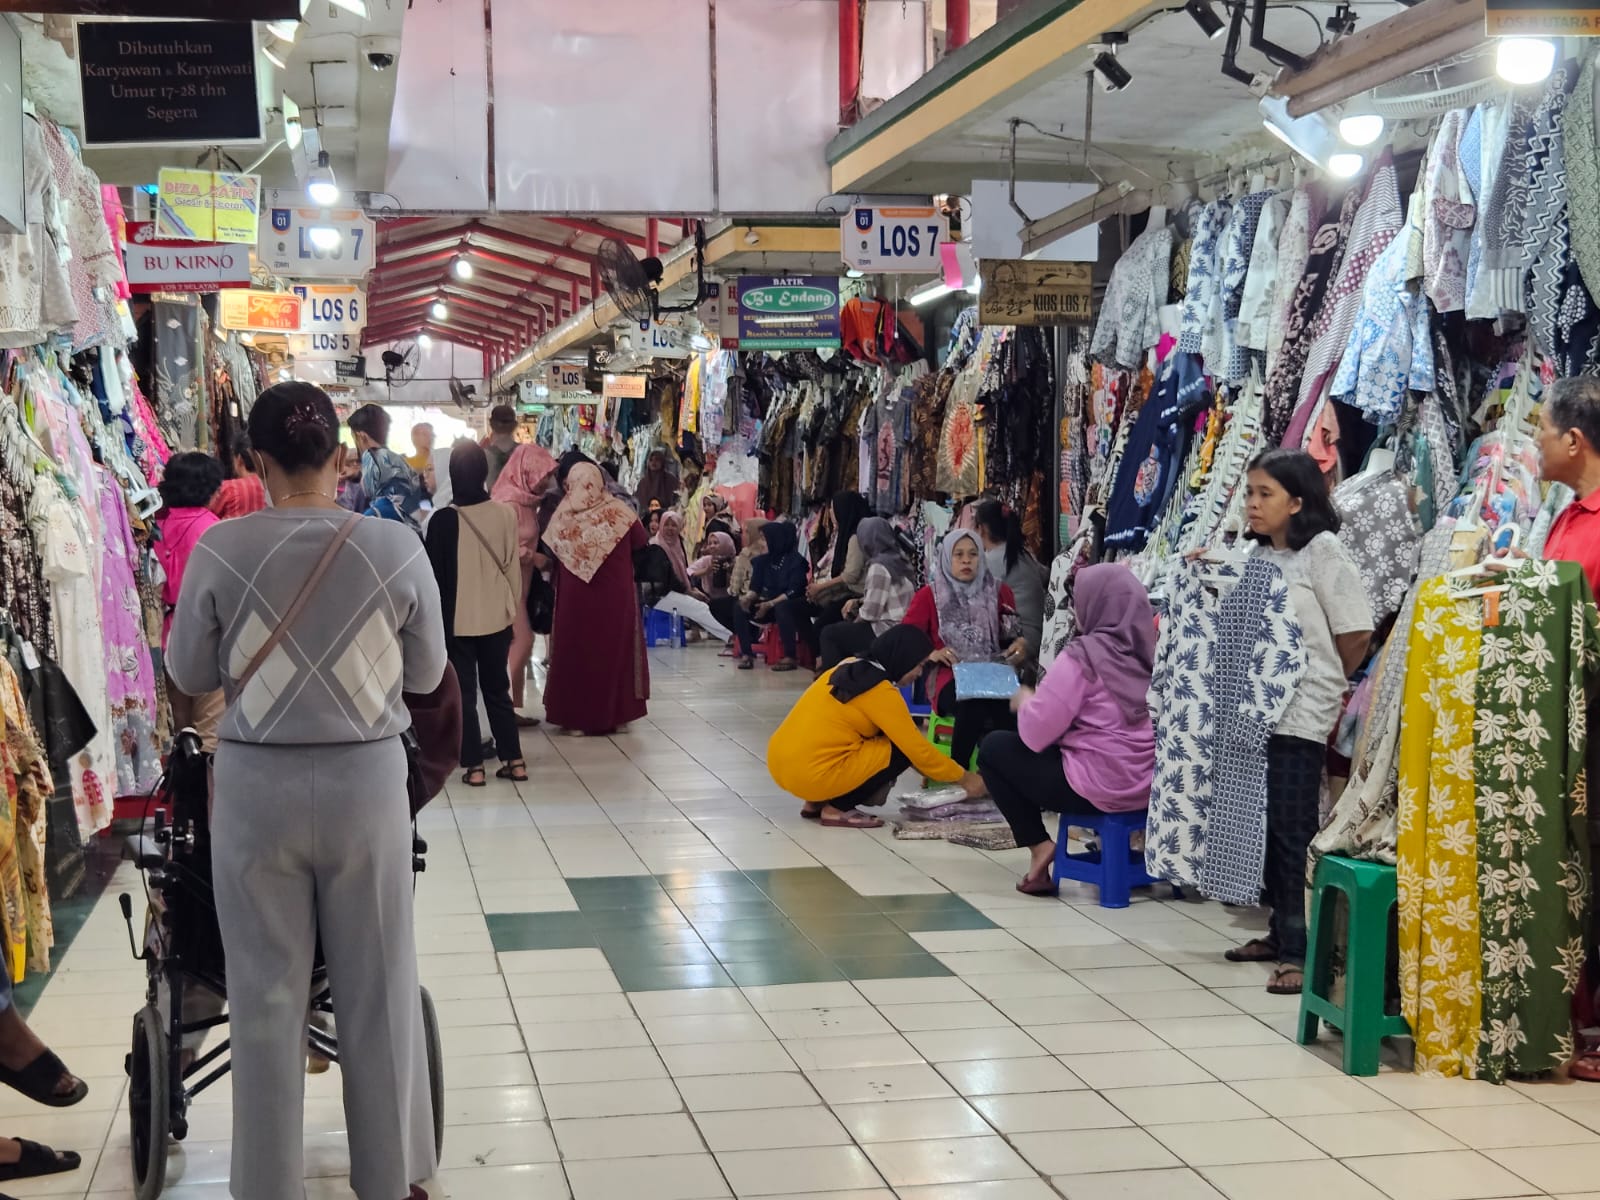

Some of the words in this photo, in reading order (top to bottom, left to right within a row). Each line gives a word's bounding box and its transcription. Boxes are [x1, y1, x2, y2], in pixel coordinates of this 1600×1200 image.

[1543, 15, 1591, 28] UTARA
[118, 40, 213, 55] Dibutuhkan
[85, 63, 161, 80] Karyawan
[176, 61, 252, 79] Karyawati
[110, 84, 157, 98] Umur
[161, 83, 197, 100] 17-28
[200, 83, 226, 97] thn
[146, 106, 198, 122] Segera
[277, 216, 287, 226] 01
[859, 217, 869, 226] 01
[350, 228, 364, 261] 7
[880, 225, 920, 257] LOS
[927, 225, 939, 257] 7
[143, 255, 169, 271] BU
[175, 254, 234, 270] KIRNO
[772, 278, 804, 286] BATIK
[745, 290, 773, 306] Bu
[778, 290, 832, 306] Endang
[1033, 294, 1057, 312] KIOS
[1060, 294, 1079, 313] LOS
[1082, 295, 1089, 313] 7
[312, 298, 343, 322] LOS
[349, 298, 358, 322] 6
[312, 334, 337, 350] LOS
[342, 334, 350, 350] 5
[562, 372, 580, 385] LOS
